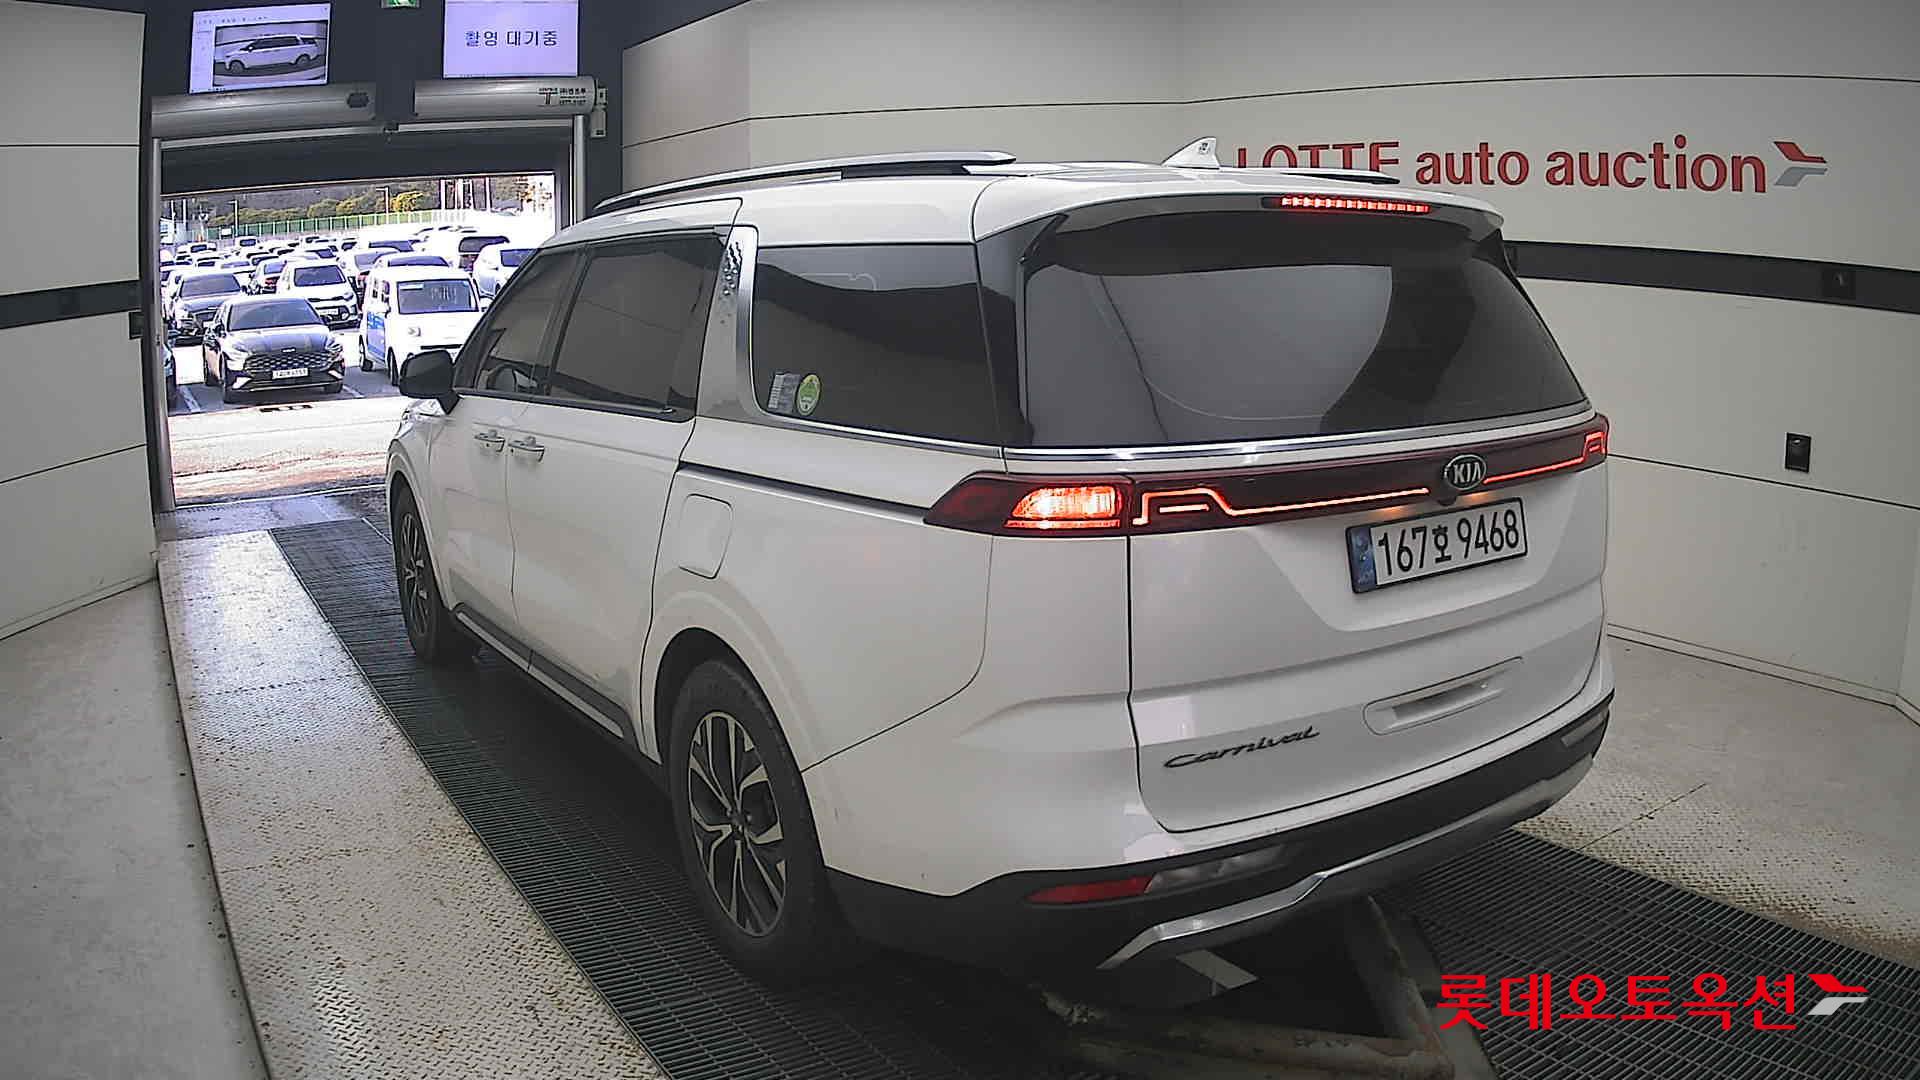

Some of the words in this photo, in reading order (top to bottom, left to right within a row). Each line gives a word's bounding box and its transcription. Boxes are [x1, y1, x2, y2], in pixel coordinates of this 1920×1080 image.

[506, 30, 558, 47] 대기중
[1415, 142, 1530, 186] auto
[1545, 134, 1767, 193] auction
[1452, 461, 1483, 485] KIA
[1378, 524, 1453, 576] 167호
[1456, 508, 1520, 560] 9468
[1163, 725, 1321, 769] Carnival
